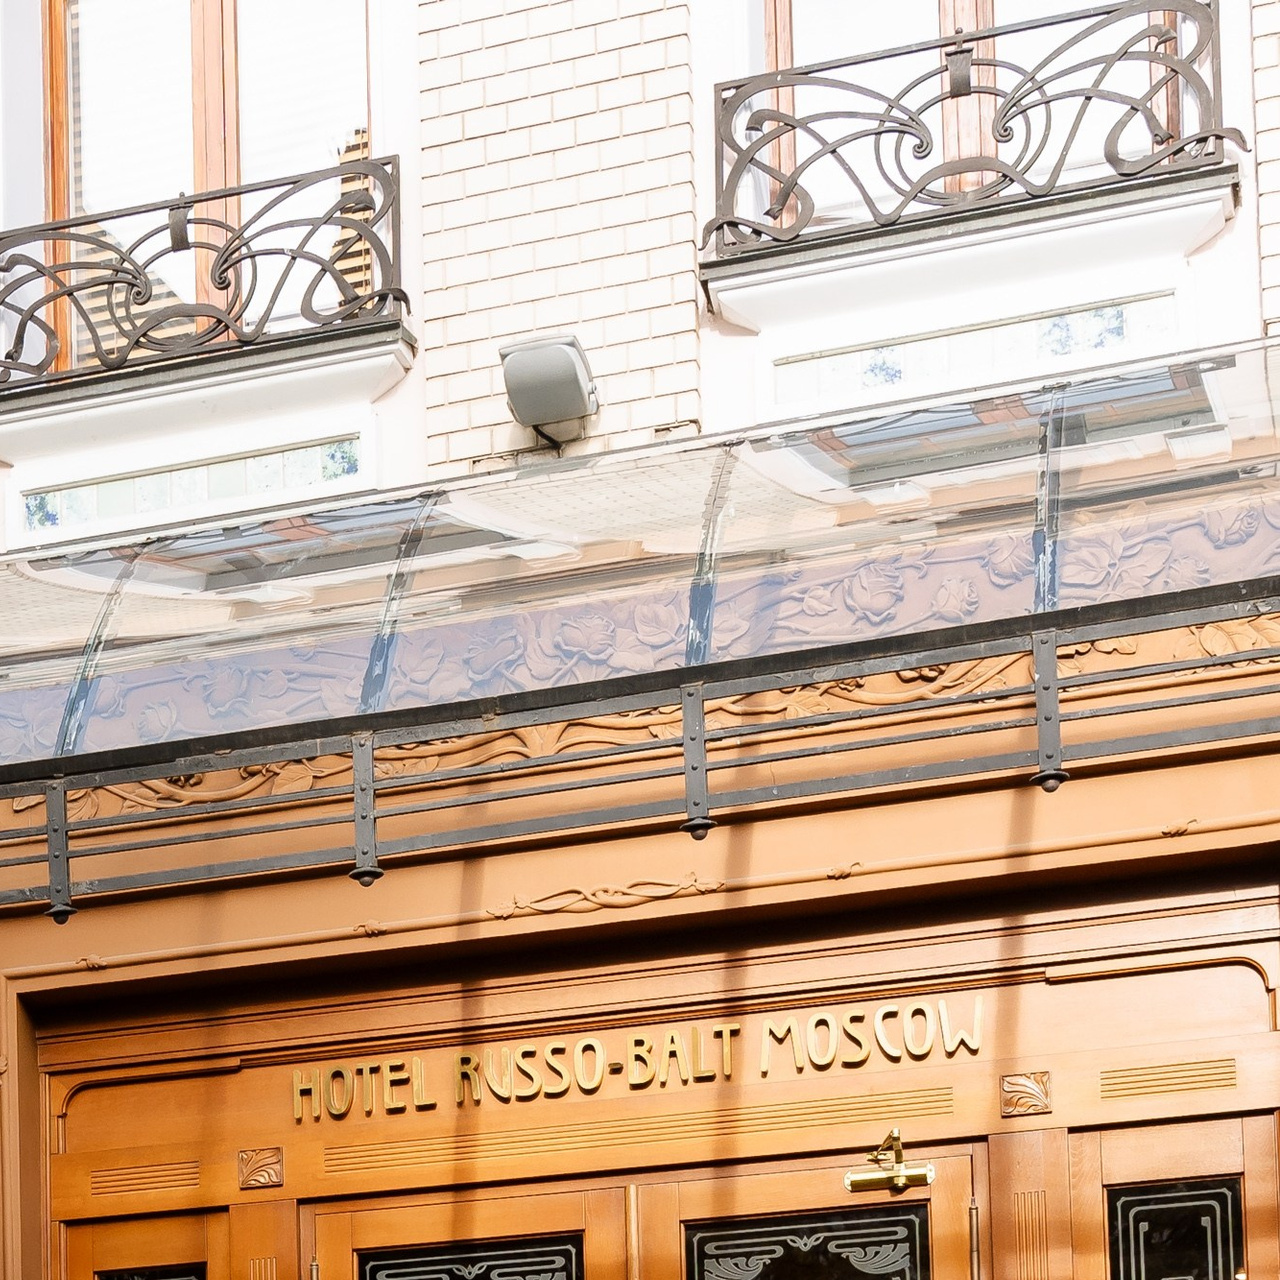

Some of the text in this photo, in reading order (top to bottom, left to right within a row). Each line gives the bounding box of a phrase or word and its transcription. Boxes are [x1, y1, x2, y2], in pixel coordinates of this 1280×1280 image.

[292, 994, 985, 1122] HOTEL RUSSO-BALT MOSCOW
